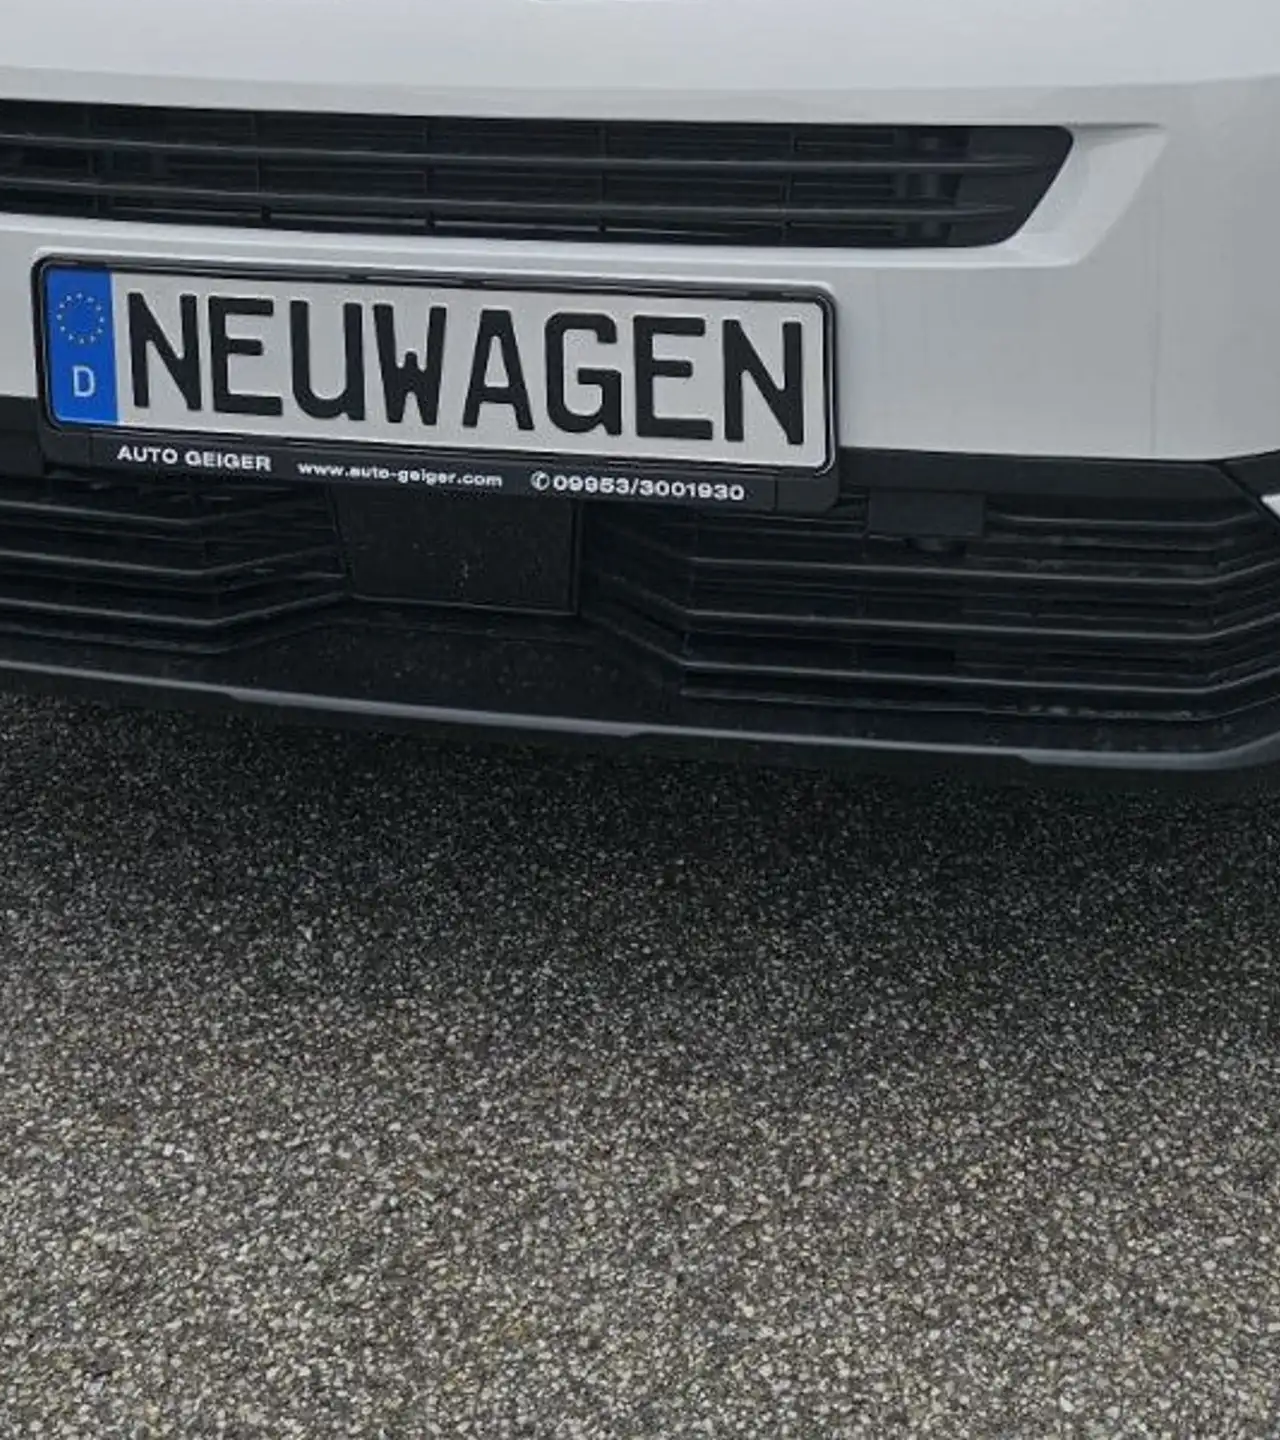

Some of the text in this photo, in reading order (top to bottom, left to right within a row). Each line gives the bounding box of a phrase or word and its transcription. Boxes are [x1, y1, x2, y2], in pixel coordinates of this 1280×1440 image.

[73, 365, 96, 397] D
[127, 291, 804, 446] NEUWAGEN
[117, 444, 745, 501] AUTO GEIGER www.auto-geiger.com 09953/3001930
